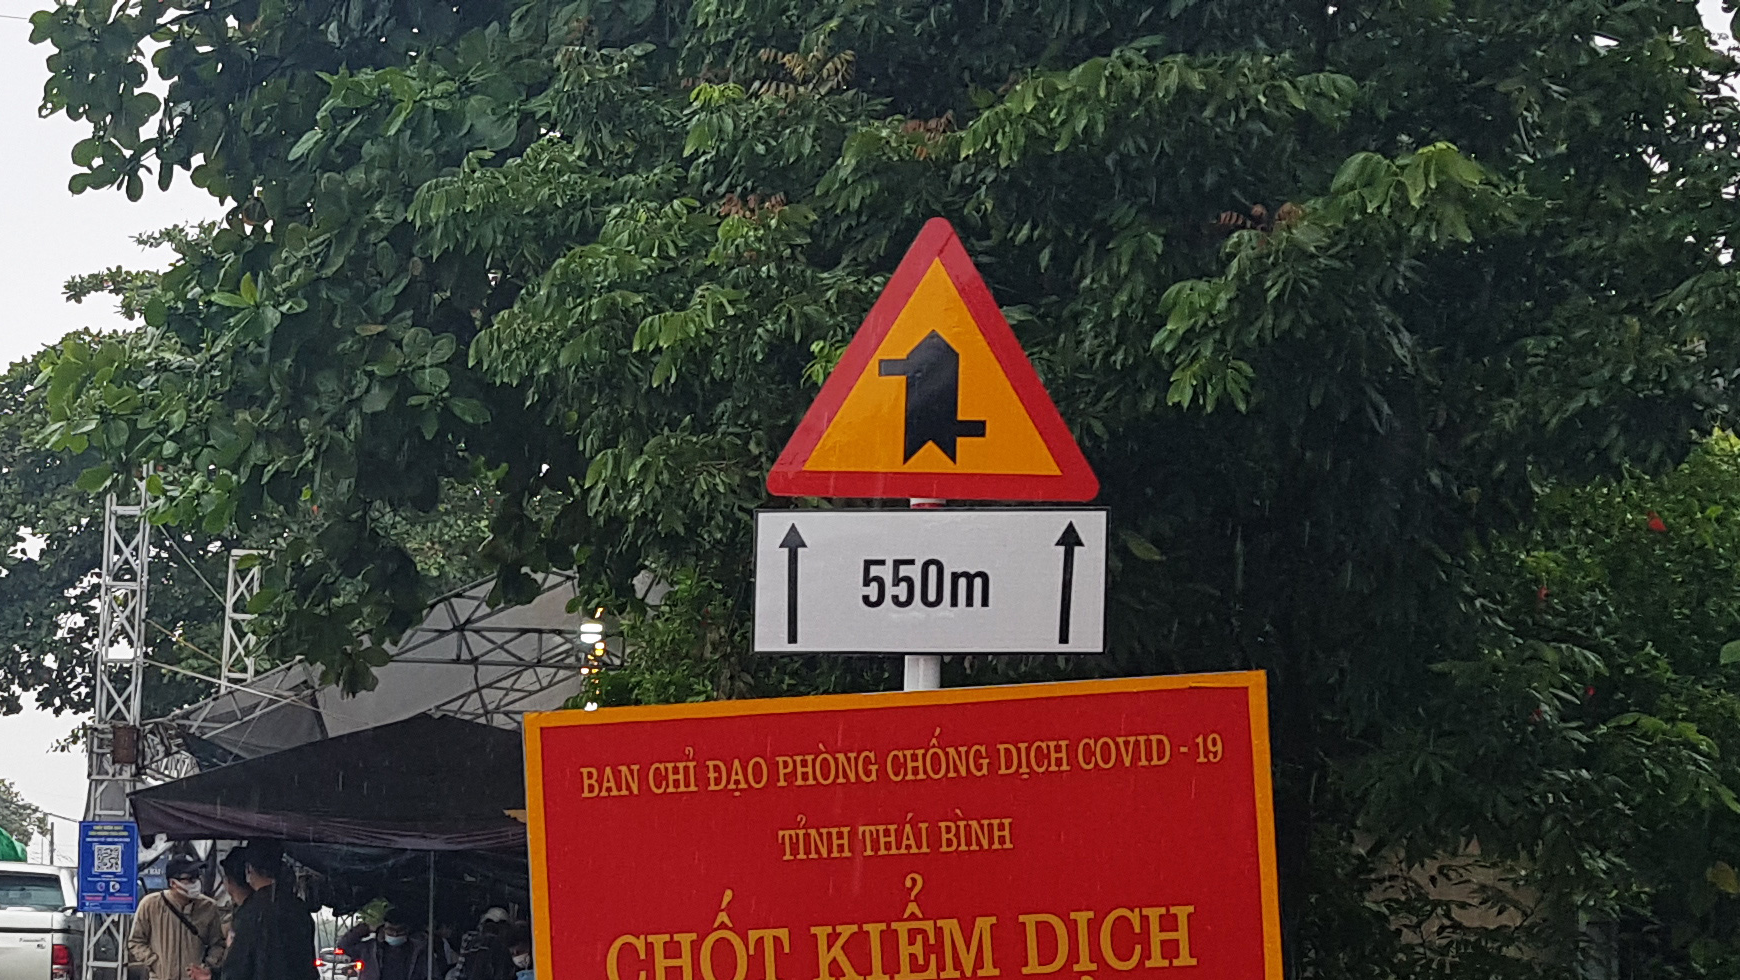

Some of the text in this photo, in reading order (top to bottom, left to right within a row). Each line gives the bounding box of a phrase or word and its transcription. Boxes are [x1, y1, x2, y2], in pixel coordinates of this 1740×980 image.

[861, 557, 990, 608] 550m
[580, 764, 640, 798] BAN
[648, 746, 699, 795] CHỈ
[706, 756, 768, 797] ĐẠO
[775, 743, 879, 787] PHÒNG
[886, 726, 990, 782] CHỐNG
[997, 739, 1071, 779] DỊCH
[1077, 733, 1172, 770] COVID
[1195, 733, 1223, 763] 19
[778, 808, 1014, 861] TỈNH THÁI BÌNH
